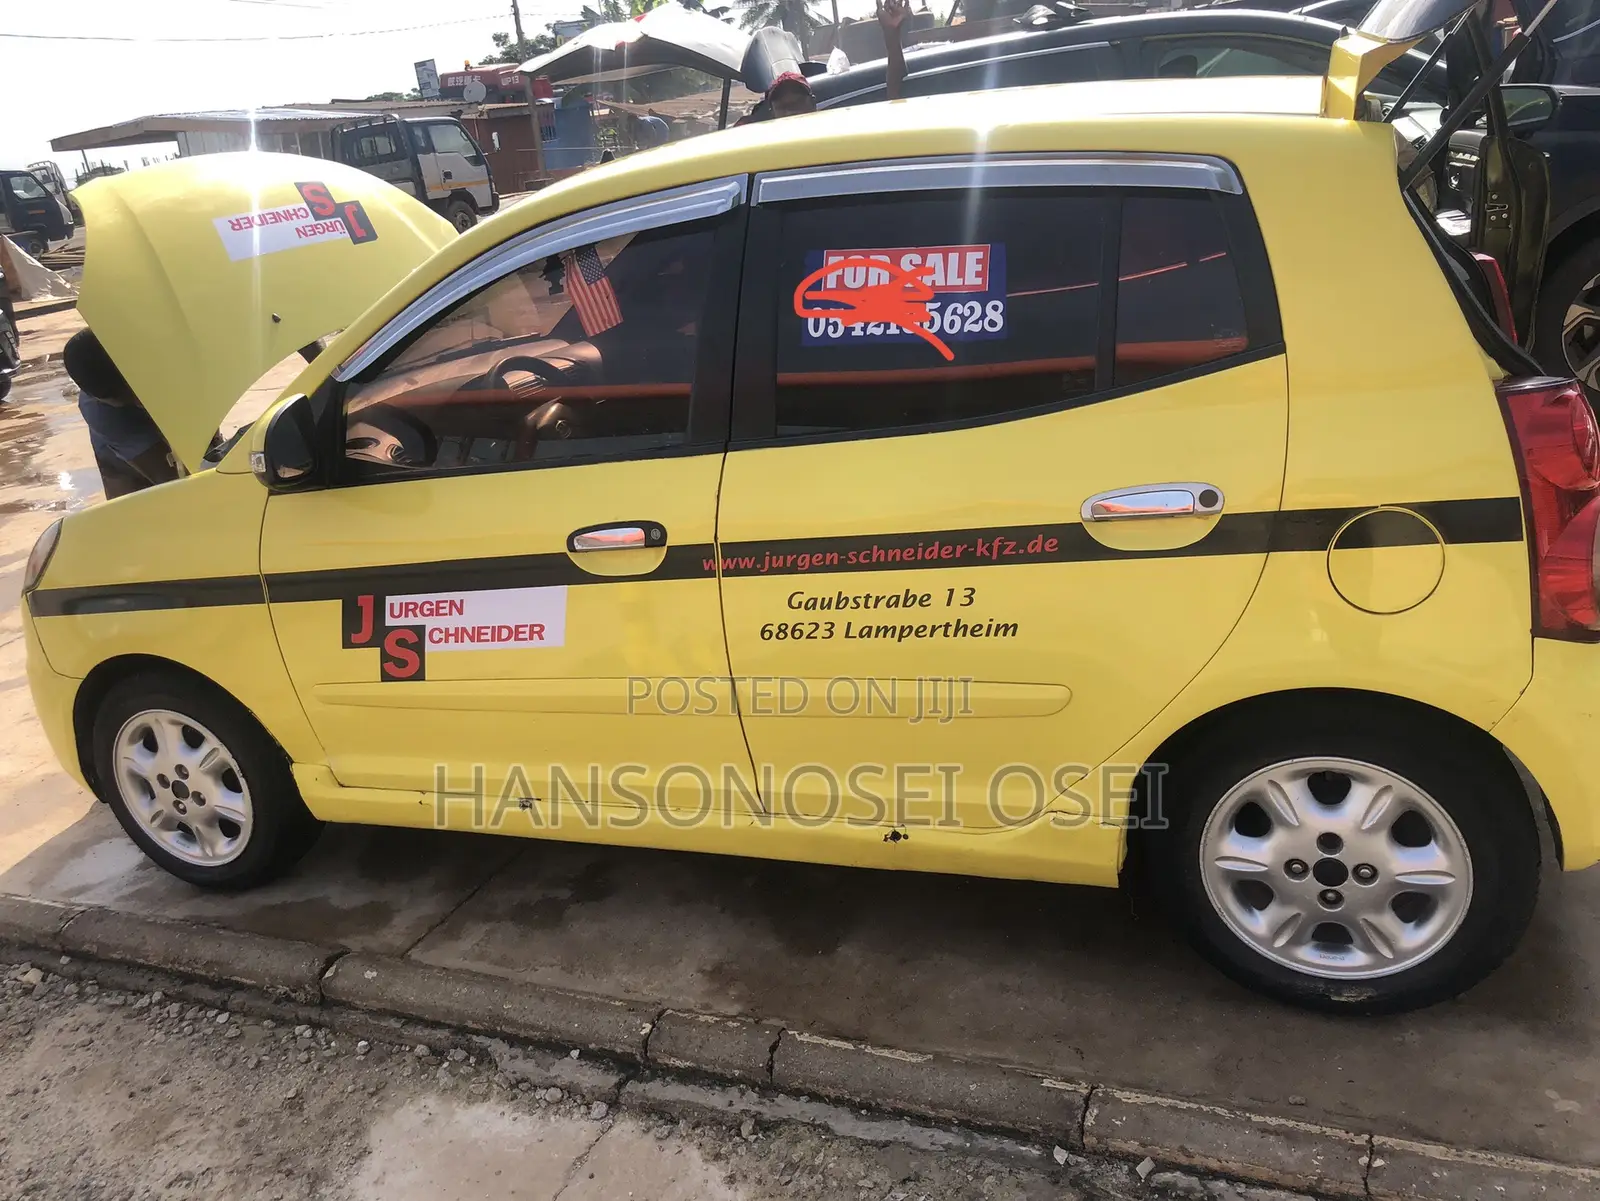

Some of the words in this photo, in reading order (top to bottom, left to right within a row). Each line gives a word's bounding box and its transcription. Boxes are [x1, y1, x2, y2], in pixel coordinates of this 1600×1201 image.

[900, 251, 984, 288] SALE
[807, 300, 1004, 338] 055628
[702, 534, 1059, 573] www.jurgen-schneider-kfz.de
[787, 588, 932, 612] Gaubstrabe
[944, 587, 976, 608] 13
[760, 621, 835, 641] 68623
[844, 618, 1019, 642] Lampertheim
